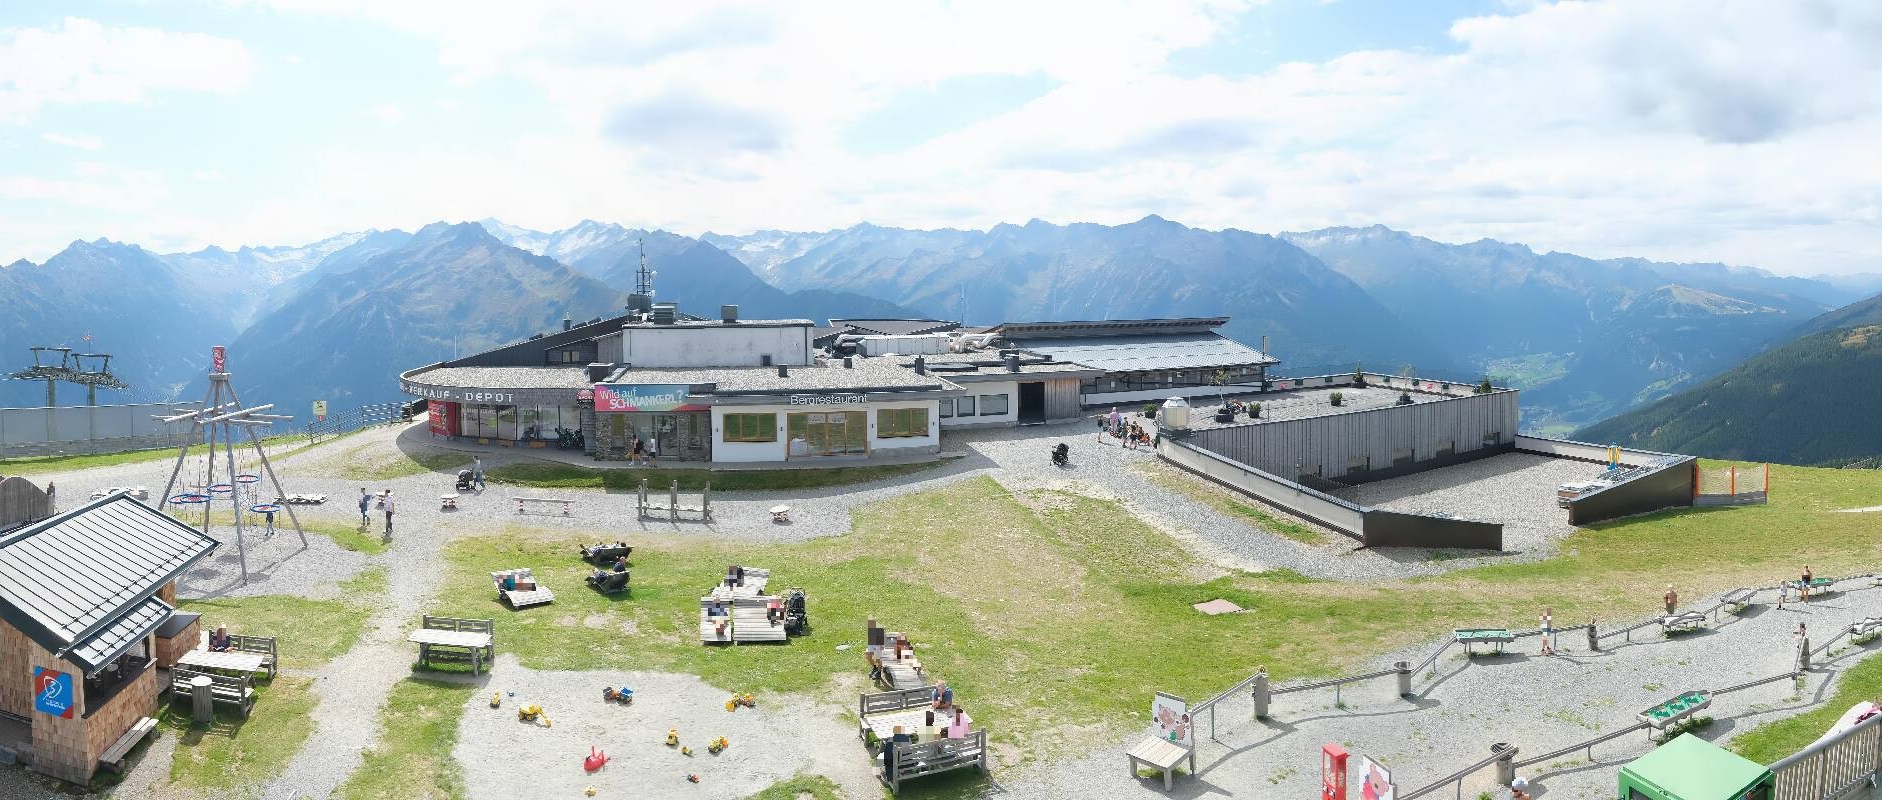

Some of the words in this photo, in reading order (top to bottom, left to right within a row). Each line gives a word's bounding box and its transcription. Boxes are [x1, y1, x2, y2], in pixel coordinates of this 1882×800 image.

[408, 386, 450, 399] VERKAUF
[465, 392, 515, 403] DEPOT
[599, 389, 620, 400] Wild
[622, 387, 637, 398] auf
[790, 394, 868, 406] Bergrestaurant
